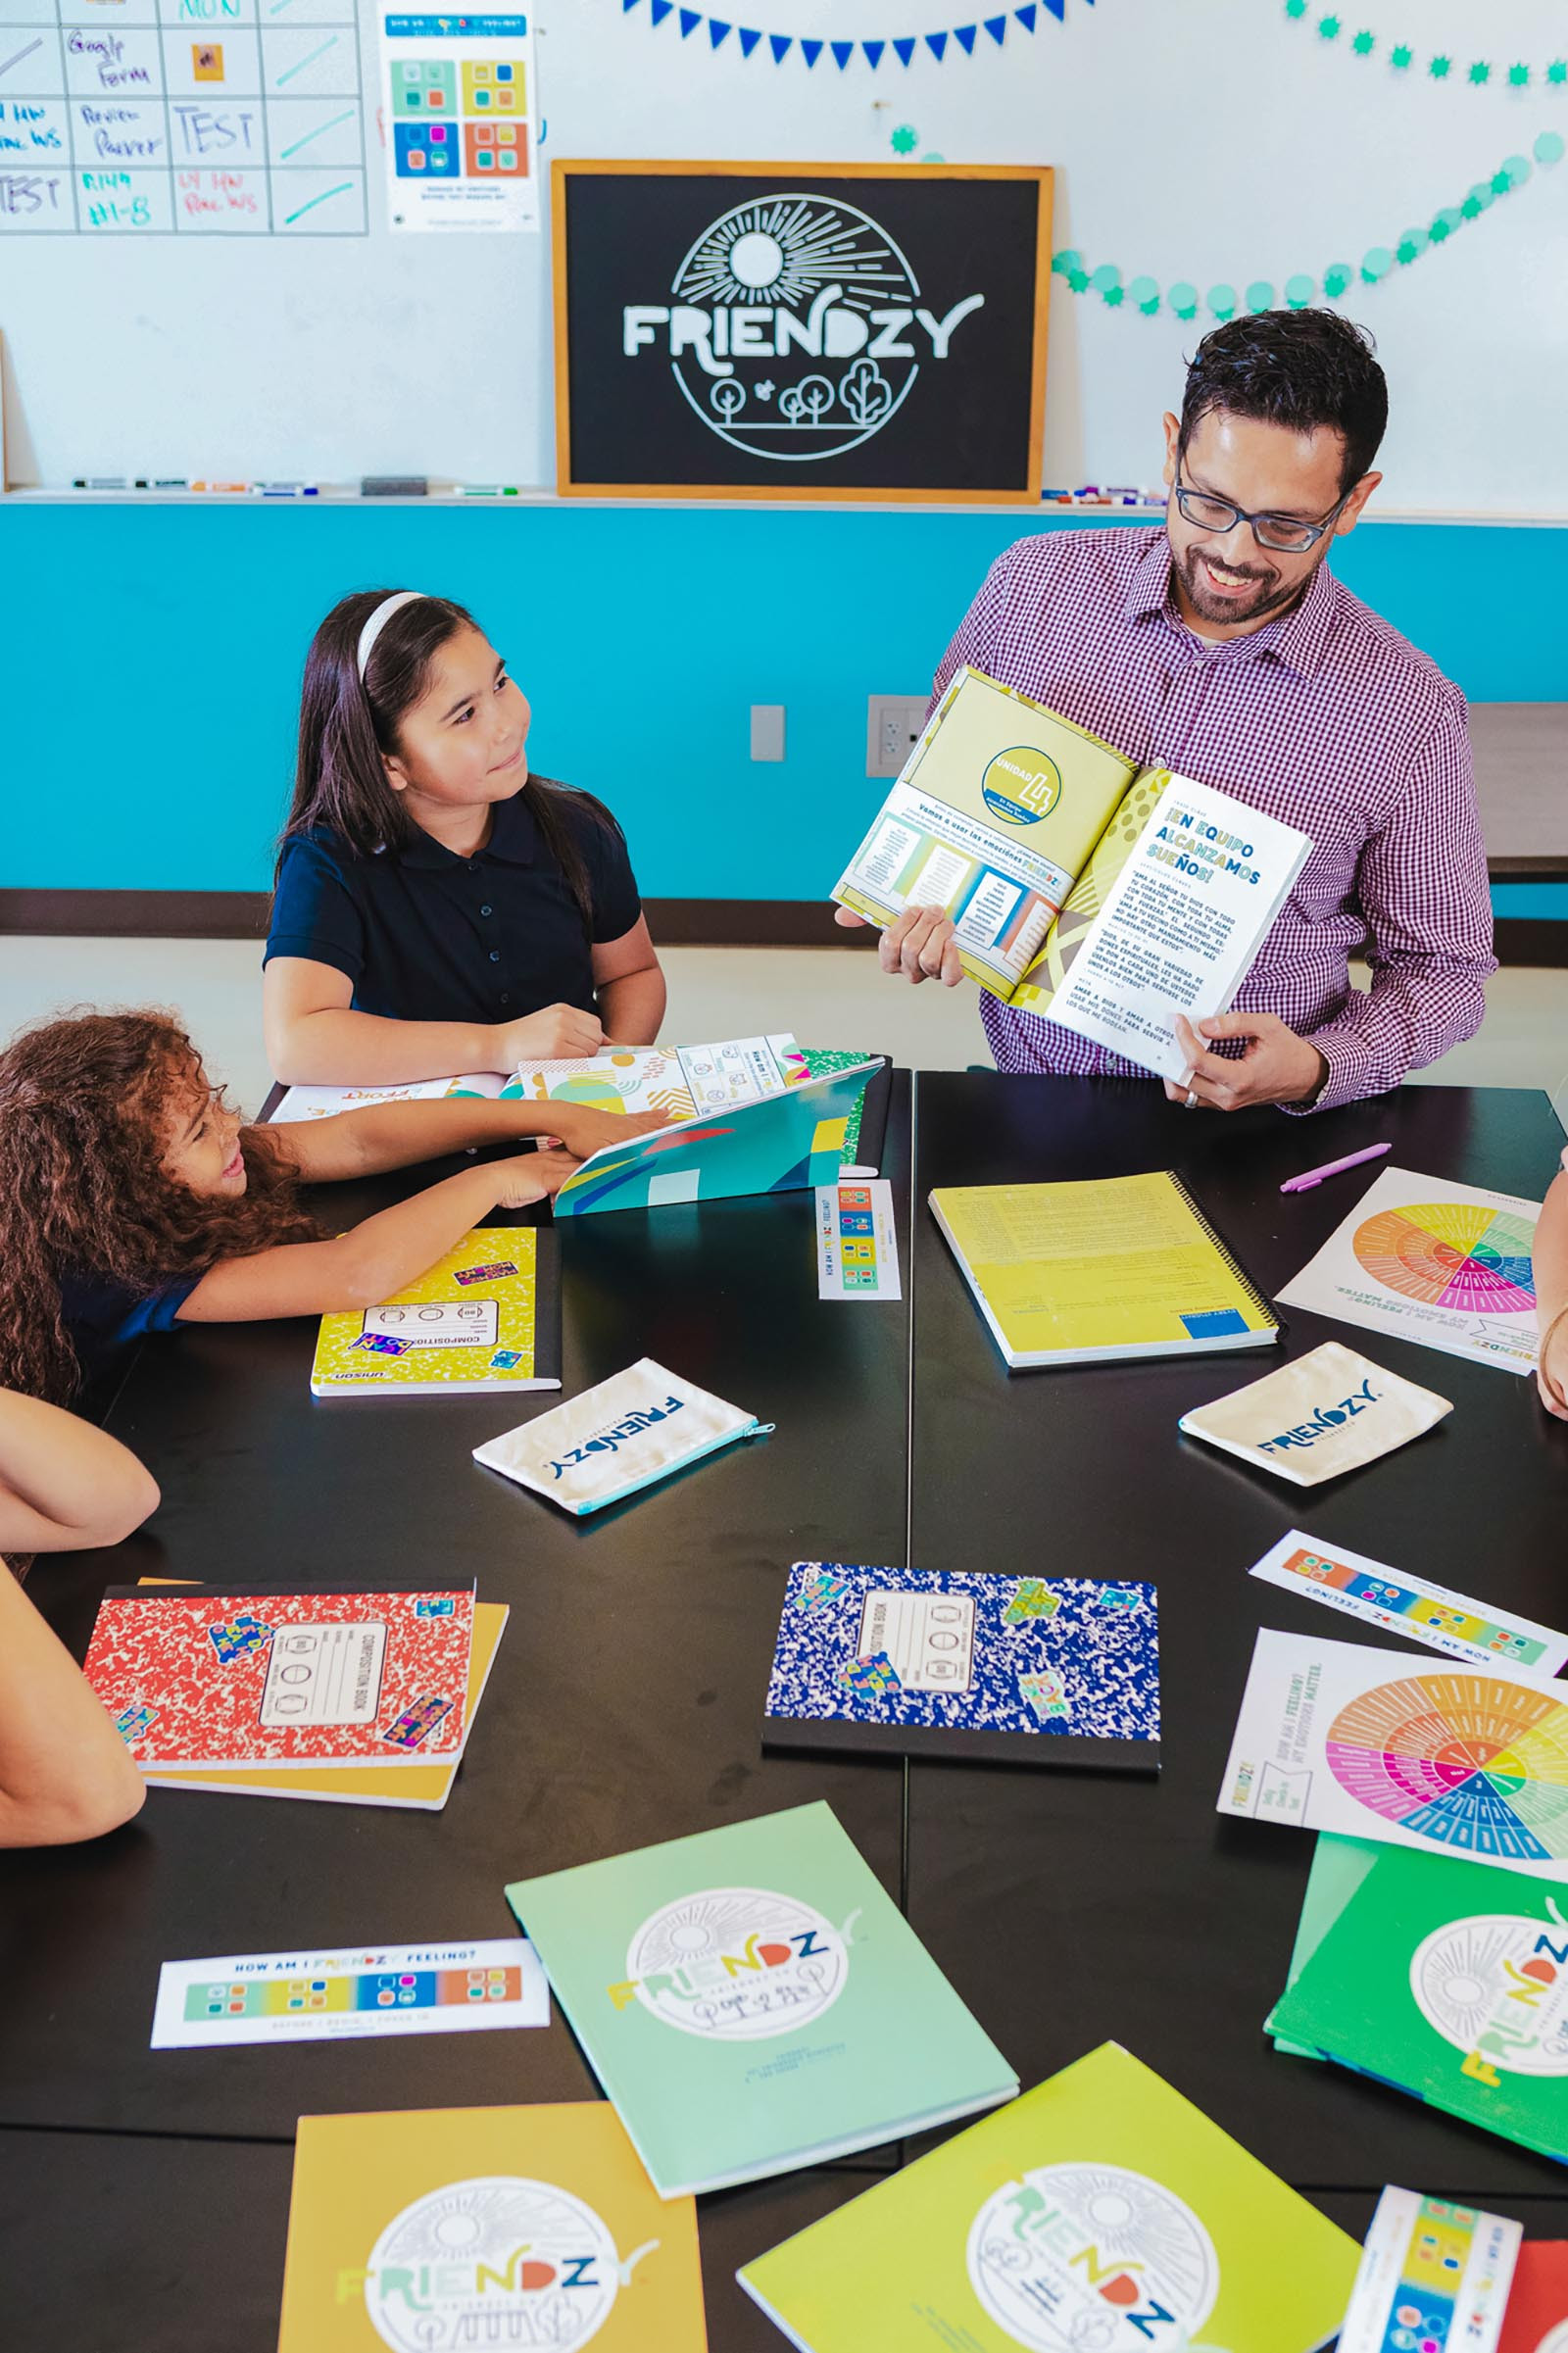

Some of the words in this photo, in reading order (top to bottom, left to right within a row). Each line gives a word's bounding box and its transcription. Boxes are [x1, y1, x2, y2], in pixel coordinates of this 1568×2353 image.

[173, 106, 253, 153] TEST
[623, 283, 985, 376] FRIENDZY
[995, 756, 1033, 782] UNIDAD
[917, 803, 944, 821] Vamos
[950, 821, 968, 834] usar
[968, 830, 983, 842] las
[1195, 820, 1254, 858] EQUIPO
[1147, 843, 1214, 884] SUEÑOS!
[1155, 826, 1261, 886] ALCANZAMOS
[1122, 891, 1134, 901] TUS
[1182, 921, 1211, 940] SEGUNDO
[1126, 884, 1140, 895] CON
[1140, 891, 1156, 904] TODA
[1156, 900, 1166, 908] TU
[1166, 905, 1187, 919] MENTE
[1193, 918, 1207, 929] CON
[1207, 925, 1228, 940] TODAS
[1130, 877, 1139, 886] TU
[1170, 898, 1185, 909] CON
[1186, 906, 1202, 918] TODA
[1203, 914, 1213, 923] TU
[1157, 881, 1178, 896] SEÑOR
[1178, 892, 1188, 901] TU
[1188, 897, 1203, 908] DIOS
[1203, 905, 1218, 916] CON
[1218, 912, 1236, 925] TODO
[1111, 912, 1148, 935] IMPORTANTE
[1147, 931, 1160, 942] QUE
[1115, 906, 1125, 915] NO
[1125, 910, 1139, 921] HAY
[1139, 918, 1155, 930] OTRO
[1156, 927, 1200, 954] MANDAMIENTO
[1201, 950, 1216, 961] MÁS
[1137, 907, 1147, 916] TU
[1146, 912, 1168, 928] VECINO
[1168, 923, 1188, 937] COMO
[1087, 957, 1103, 970] UNOS
[1108, 968, 1121, 979] LOS
[1098, 936, 1118, 951] DONES
[1159, 967, 1171, 978] LES
[1172, 974, 1182, 983] HA
[1182, 979, 1200, 992] DADO
[1105, 949, 1119, 959] DON
[1126, 959, 1143, 972] CADA
[1145, 968, 1158, 980] UNO
[1159, 976, 1168, 985] DE
[1119, 938, 1129, 947] DE
[1131, 944, 1141, 953] SU
[1142, 950, 1160, 963] GRAN
[1162, 959, 1193, 979] VARIEDAD
[1194, 976, 1203, 985] DE
[1073, 984, 1091, 997] AMAR
[1101, 998, 1116, 1009] DIOS
[1125, 1010, 1144, 1023] AMAR
[1117, 963, 1133, 976] BIEN
[1133, 972, 1151, 985] PARA
[1151, 981, 1179, 1000] SERVIRSE
[1180, 996, 1193, 1006] LOS
[1065, 998, 1077, 1008] LOS
[1077, 1004, 1090, 1014] QUE
[1090, 1010, 1101, 1020] ME
[1069, 991, 1086, 1003] USAR
[1087, 1000, 1099, 1009] MIS
[1100, 1006, 1121, 1021] DONES
[1123, 1018, 1140, 1030] PARA
[1141, 1027, 1163, 1043] SERVIR
[415, 1336, 481, 1346] COMPOSITIO
[550, 1396, 685, 1480] FRIENDZY
[1256, 1379, 1378, 1454] FRIENDZY
[1304, 1584, 1359, 1610] FEELING?
[357, 1634, 374, 1688] COMPOSITION
[1441, 1638, 1459, 1650] AM
[1462, 1646, 1491, 1662] HOW
[353, 1689, 368, 1711] BOOK
[235, 1962, 268, 1972] HOW
[274, 1960, 296, 1970] AM
[407, 1950, 475, 1962] FEELING?
[606, 1908, 862, 2011] FRIENDZY
[335, 2238, 661, 2312] FRIENDZY
